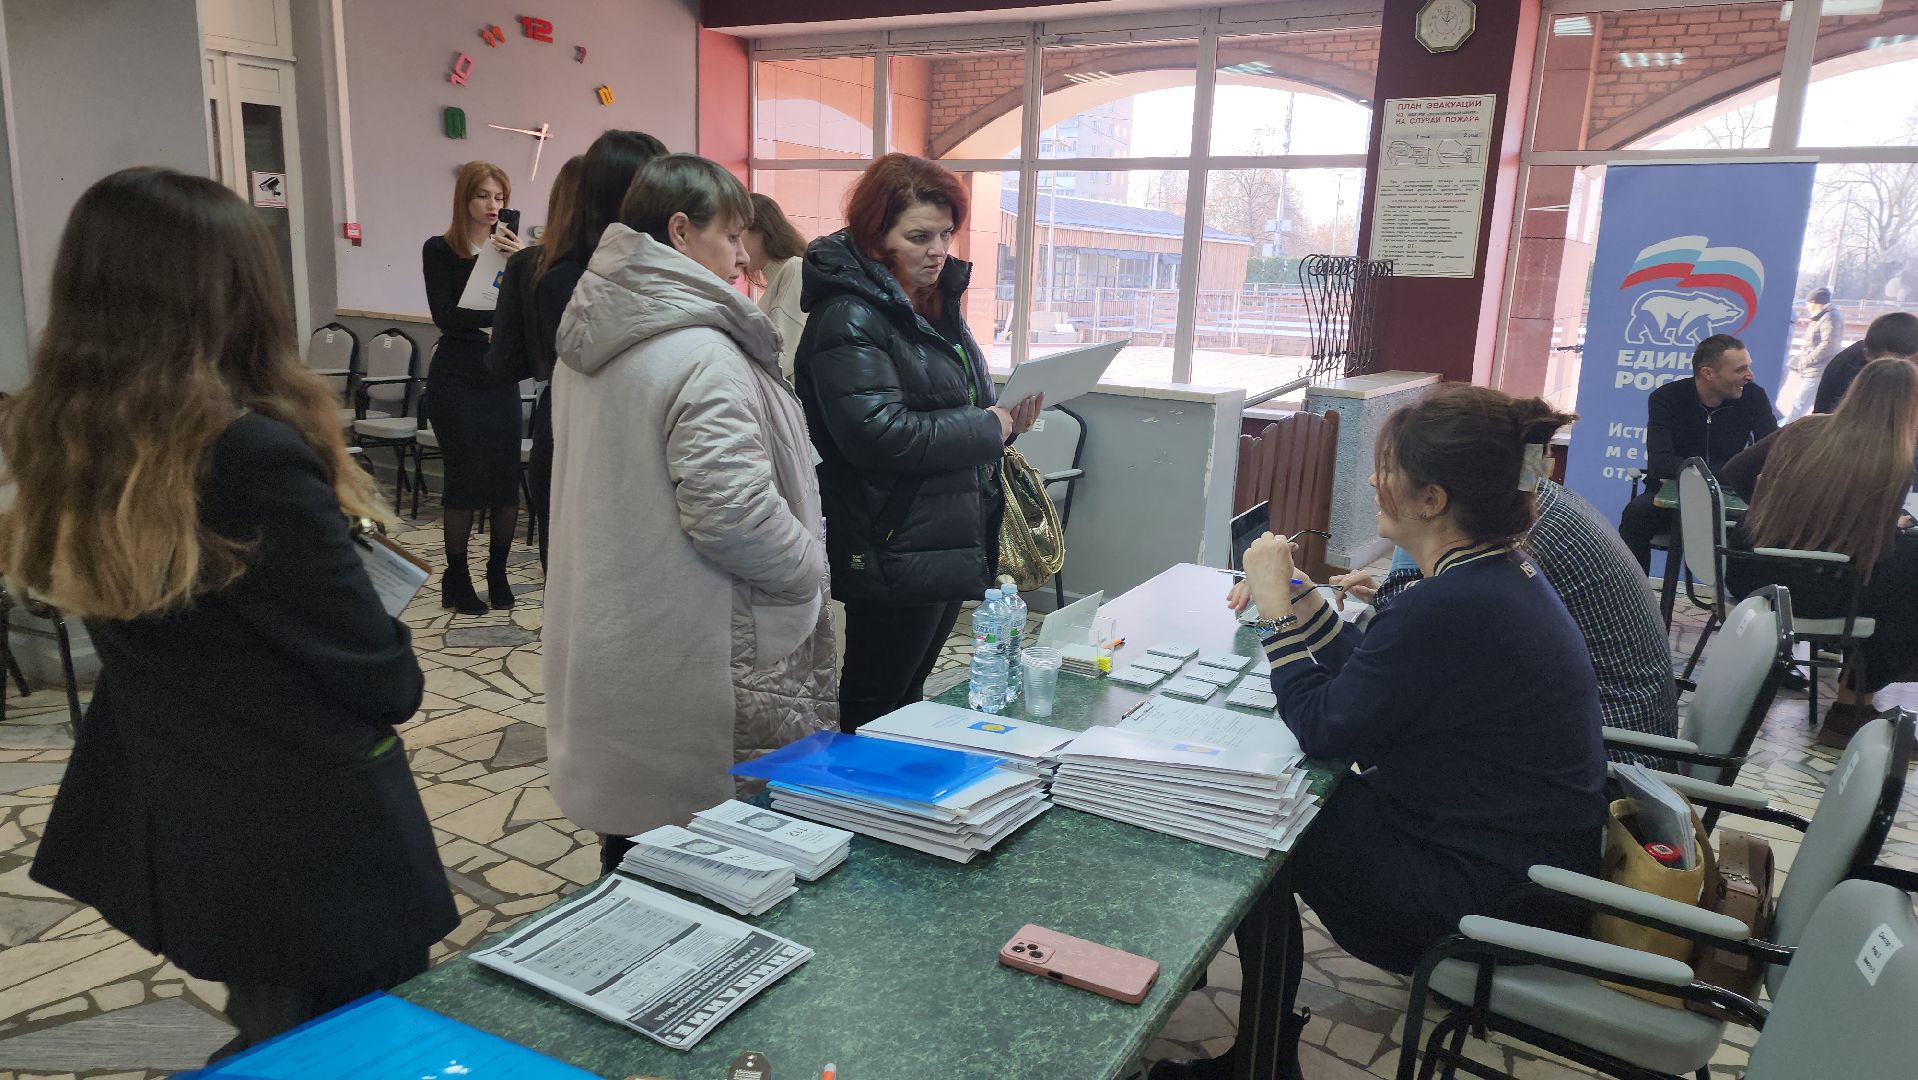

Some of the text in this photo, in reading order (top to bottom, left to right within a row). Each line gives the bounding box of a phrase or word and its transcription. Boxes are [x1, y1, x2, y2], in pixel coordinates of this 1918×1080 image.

[519, 15, 554, 43] 12
[1425, 99, 1482, 109] ЭВАКУАЦИИ
[1409, 116, 1441, 125] СЛУЧАЙ
[1617, 349, 1694, 370] ЕДИН
[1615, 371, 1694, 391] РОС
[699, 946, 762, 992] ГРАЖДАНСКАЯ
[653, 988, 701, 1022] ОБОРОНА
[665, 945, 804, 1044] ВНИМАНИЕ!
